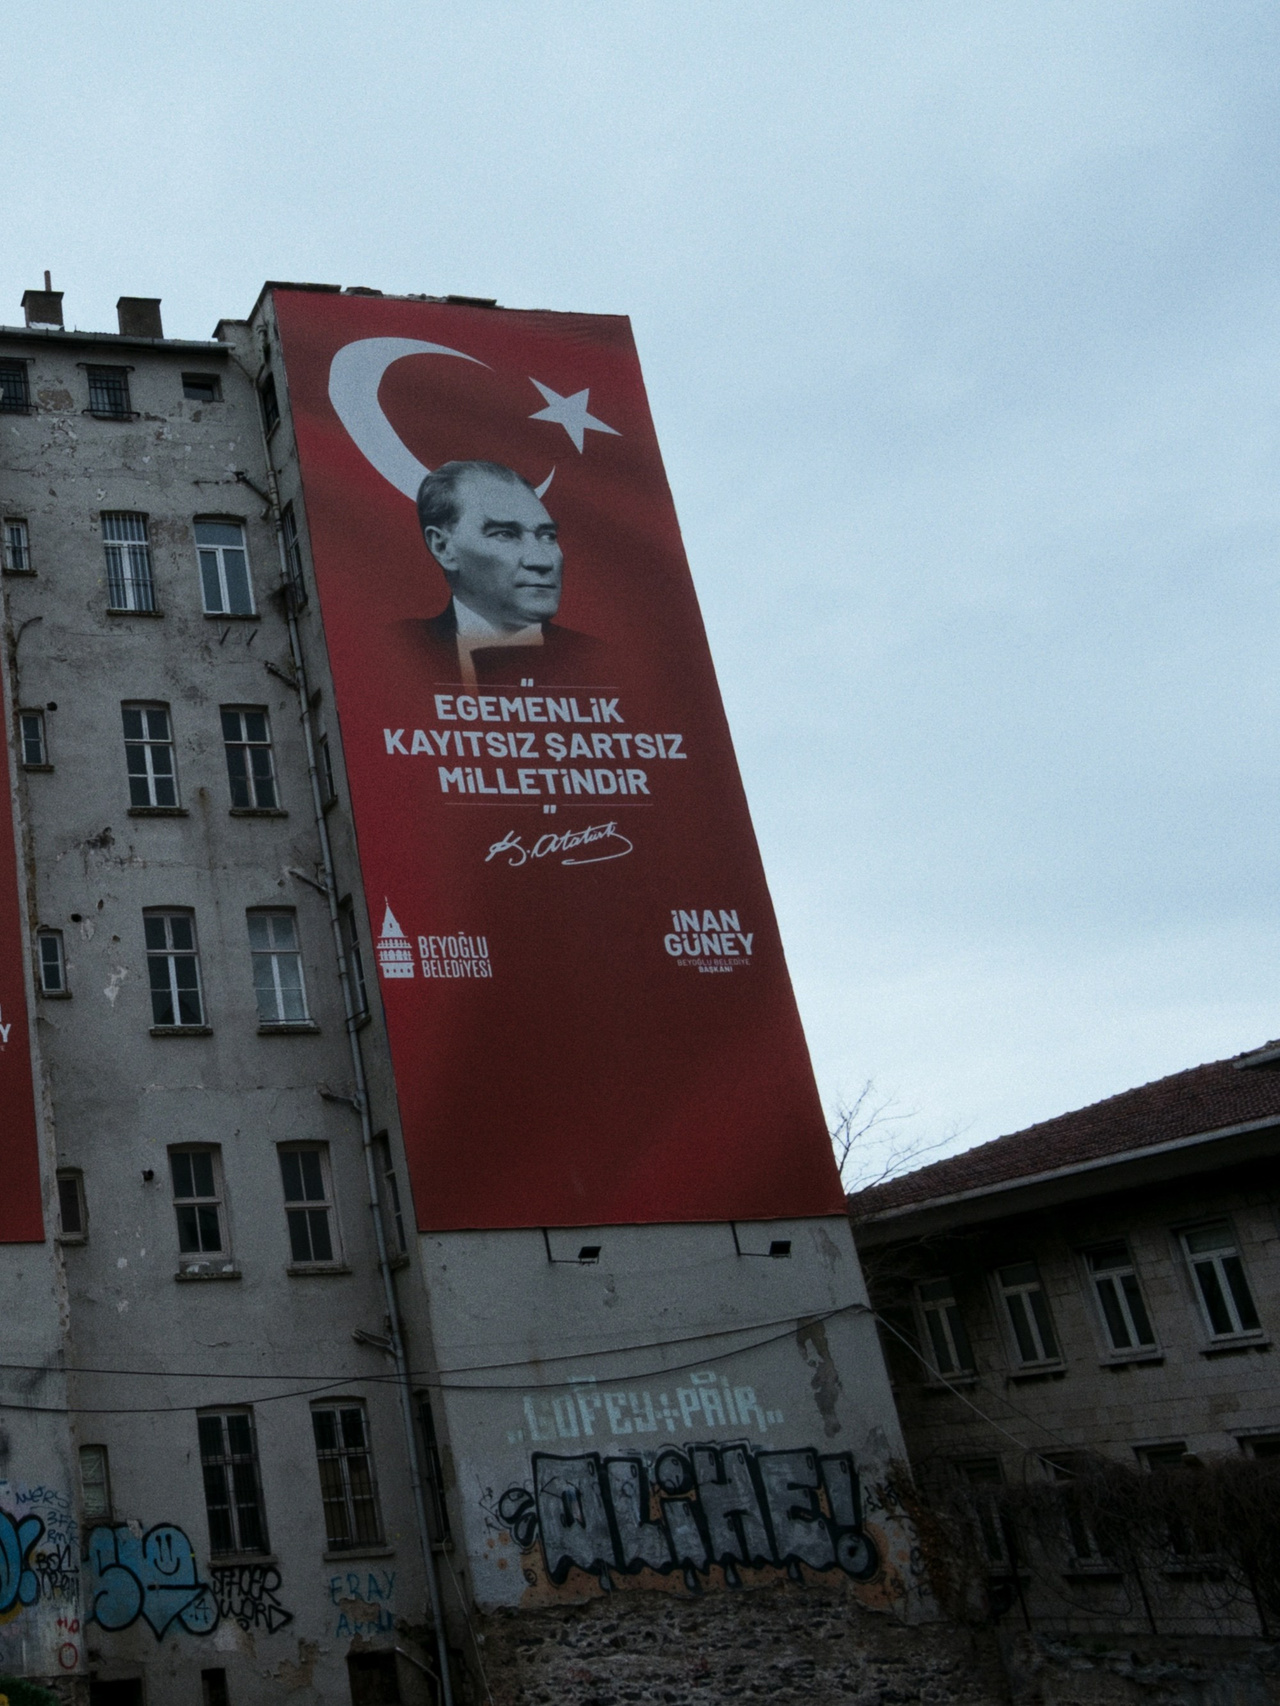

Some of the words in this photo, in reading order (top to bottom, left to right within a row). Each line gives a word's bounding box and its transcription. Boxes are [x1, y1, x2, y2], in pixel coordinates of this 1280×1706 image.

[433, 694, 624, 723] EGEMENLİK
[383, 728, 539, 758] KAYITSIZ
[545, 732, 687, 761] ŞARTSIZ
[437, 766, 650, 795] MİLLETİNDİR
[670, 909, 741, 932] İNAN
[417, 931, 489, 959] BEYOĞLU
[663, 932, 754, 957] GÜNEY
[422, 959, 493, 978] BELEDİYESİ
